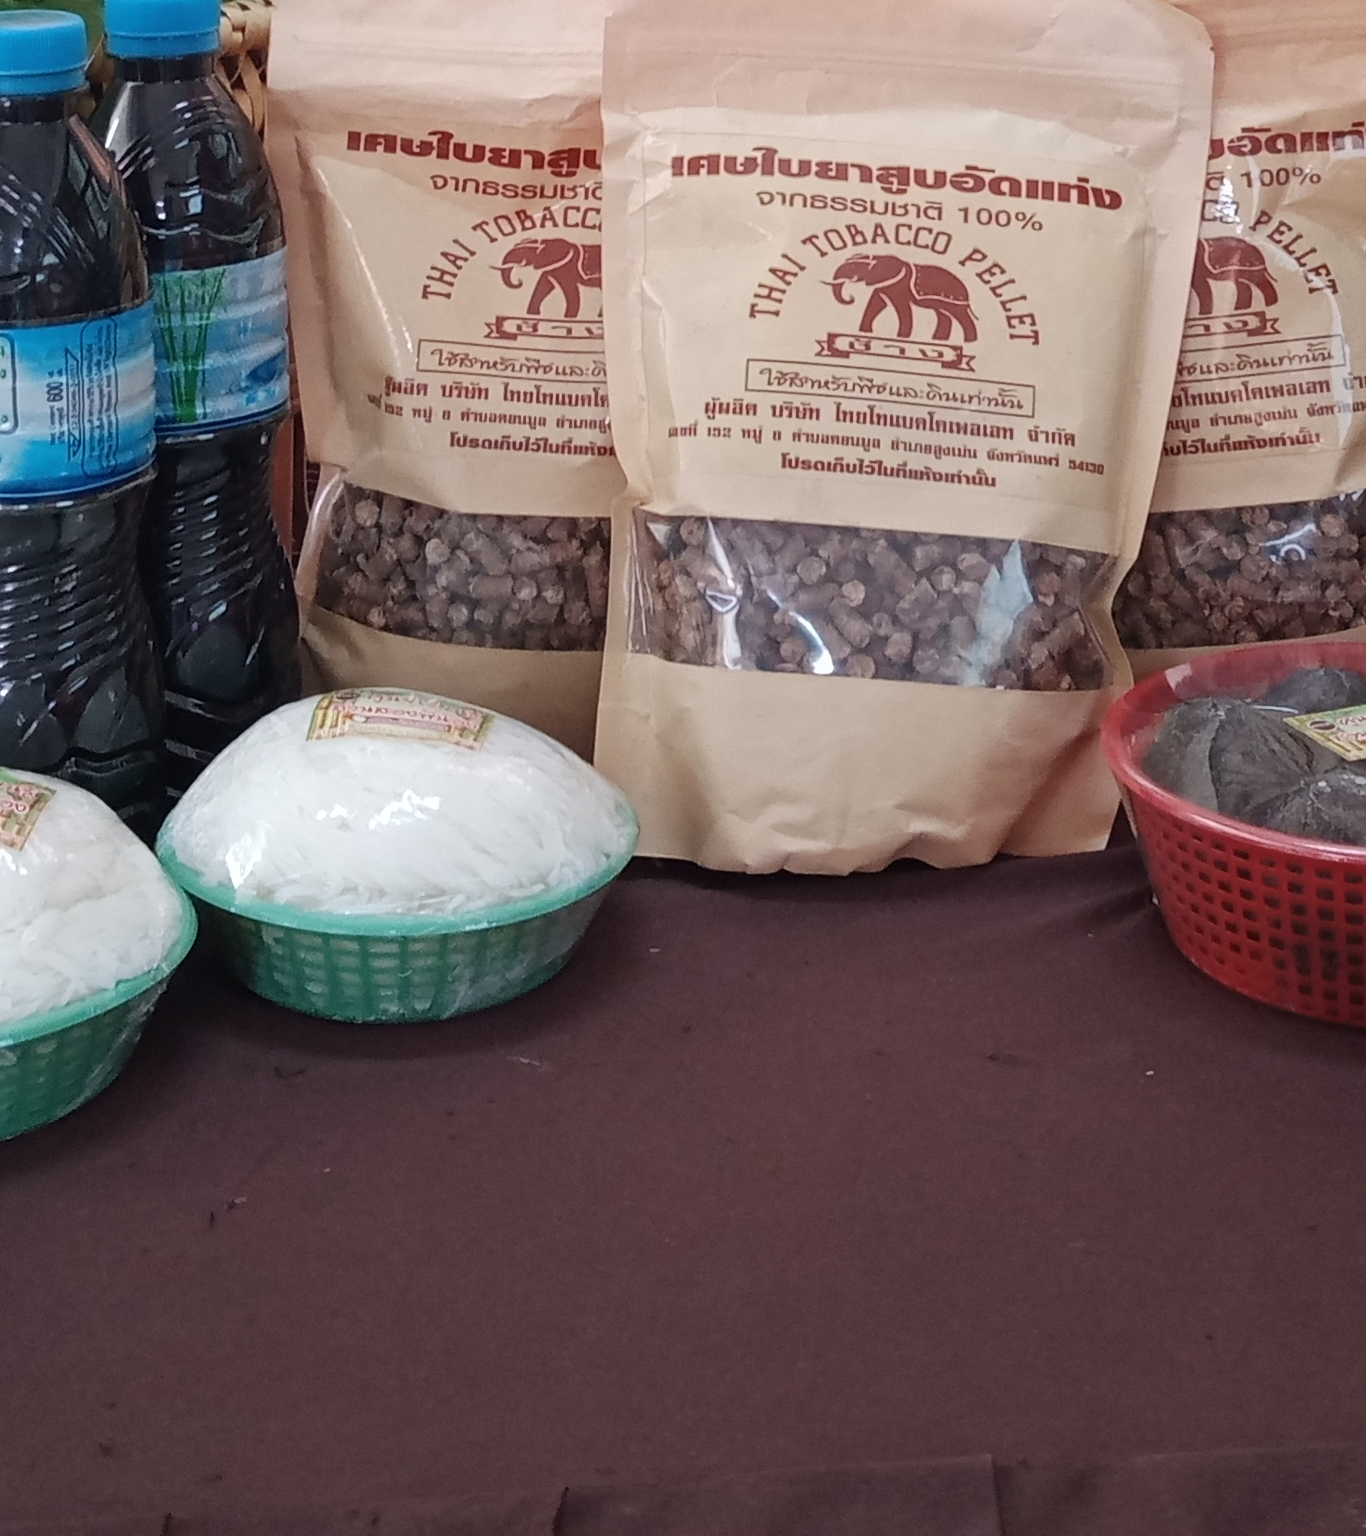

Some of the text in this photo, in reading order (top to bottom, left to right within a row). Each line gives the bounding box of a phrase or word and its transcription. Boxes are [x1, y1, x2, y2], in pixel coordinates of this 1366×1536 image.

[670, 146, 1124, 212] เศษใบยาสูบอัดแท่ง
[1239, 166, 1323, 189] 100%
[755, 190, 1044, 232] จากธรรมชาติ 100%
[421, 205, 603, 302] THAI TOBACC
[1248, 209, 1340, 296] PELLET
[748, 222, 1040, 347] THAI TOBACCO PELLET
[45, 380, 64, 404] 600
[758, 367, 1025, 410] ใช้สำหรับพืชและดินเท่านั้น
[704, 396, 758, 421] ผู้ผลิต
[770, 400, 821, 422] บริษัท
[1027, 424, 1077, 448] จำกัด
[740, 425, 764, 445] หมู่
[986, 446, 1061, 468] จังหวัดแพร่
[780, 451, 997, 488] โปรดเก็บไว้ในที่แห้งเท่านั้น
